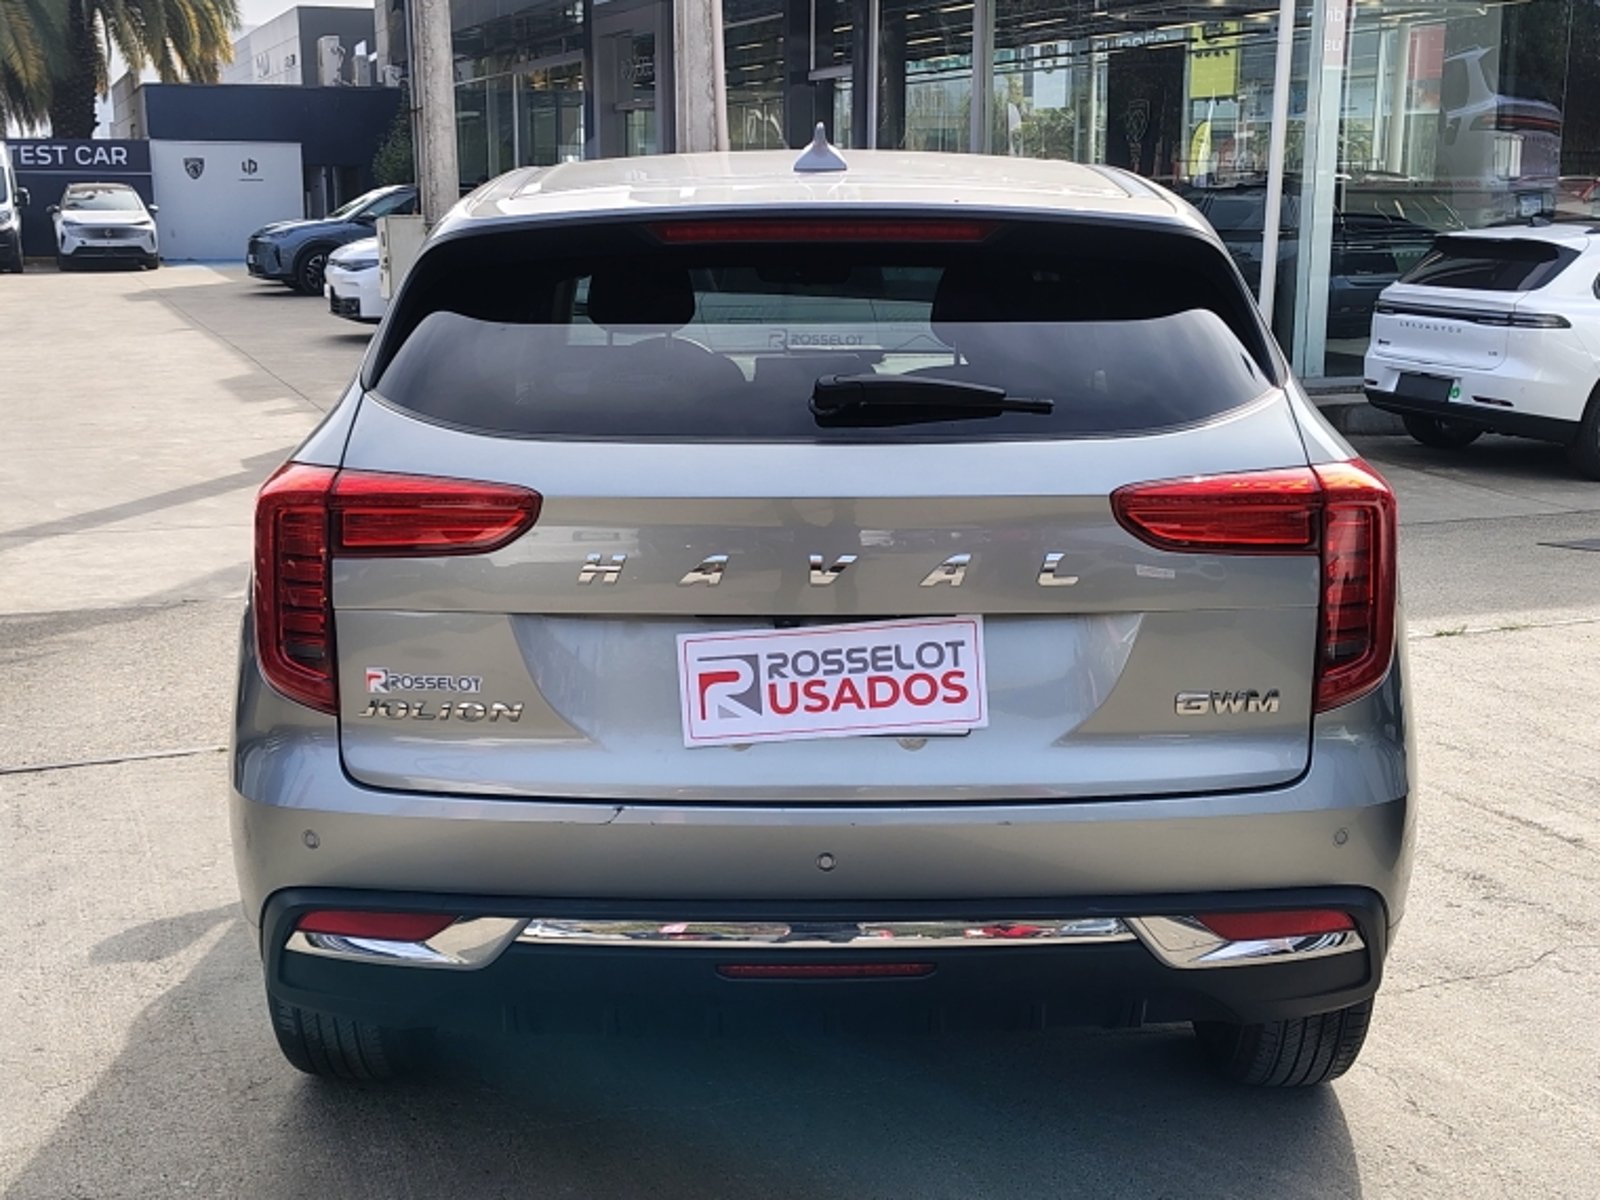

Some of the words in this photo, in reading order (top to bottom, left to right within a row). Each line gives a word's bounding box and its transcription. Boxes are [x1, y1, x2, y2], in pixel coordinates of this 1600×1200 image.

[7, 145, 68, 165] TEST
[75, 145, 128, 166] CAR
[790, 334, 864, 346] ROSSELOT
[577, 552, 1080, 588] HAVAL
[766, 639, 966, 681] ROSSELOT
[388, 674, 482, 693] ROSSELOT
[768, 670, 969, 716] USADOS
[357, 698, 525, 723] JOLION
[1174, 688, 1281, 716] GWM
